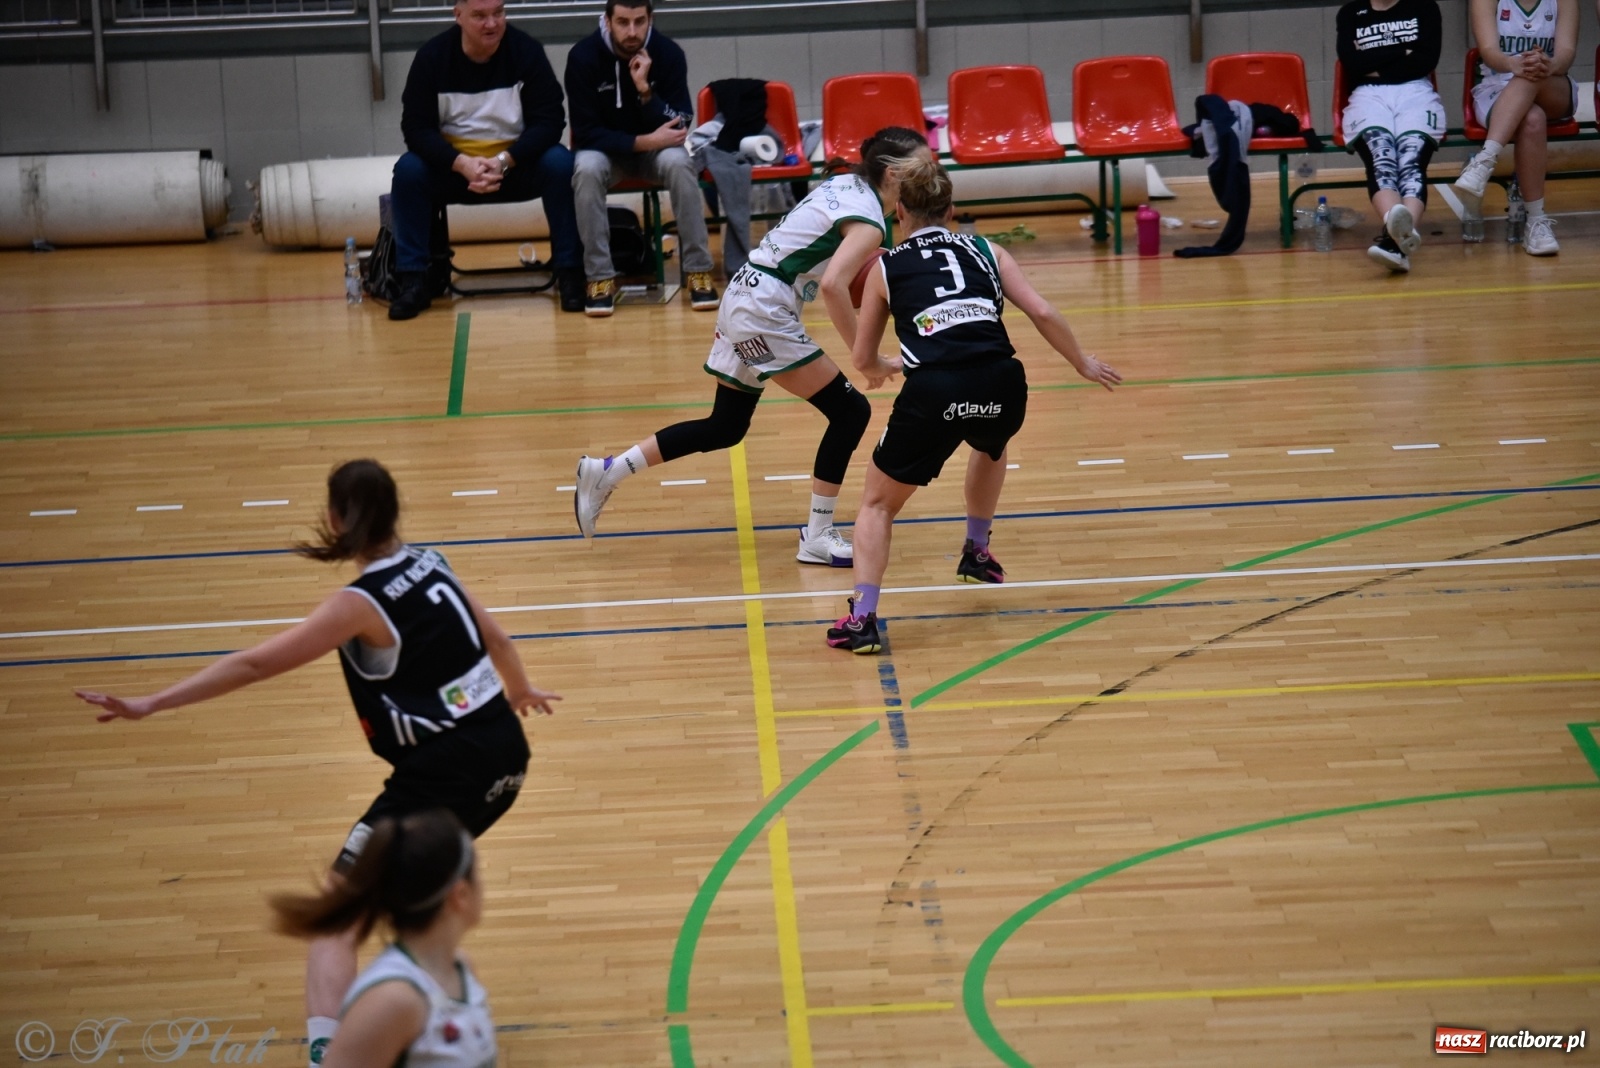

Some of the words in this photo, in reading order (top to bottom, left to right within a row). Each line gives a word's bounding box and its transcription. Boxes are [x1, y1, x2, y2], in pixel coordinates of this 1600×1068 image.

[1356, 18, 1418, 39] KATOWICE
[1426, 110, 1437, 130] 11
[920, 248, 966, 298] 3
[957, 401, 1002, 416] Clavis
[426, 582, 482, 651] 7
